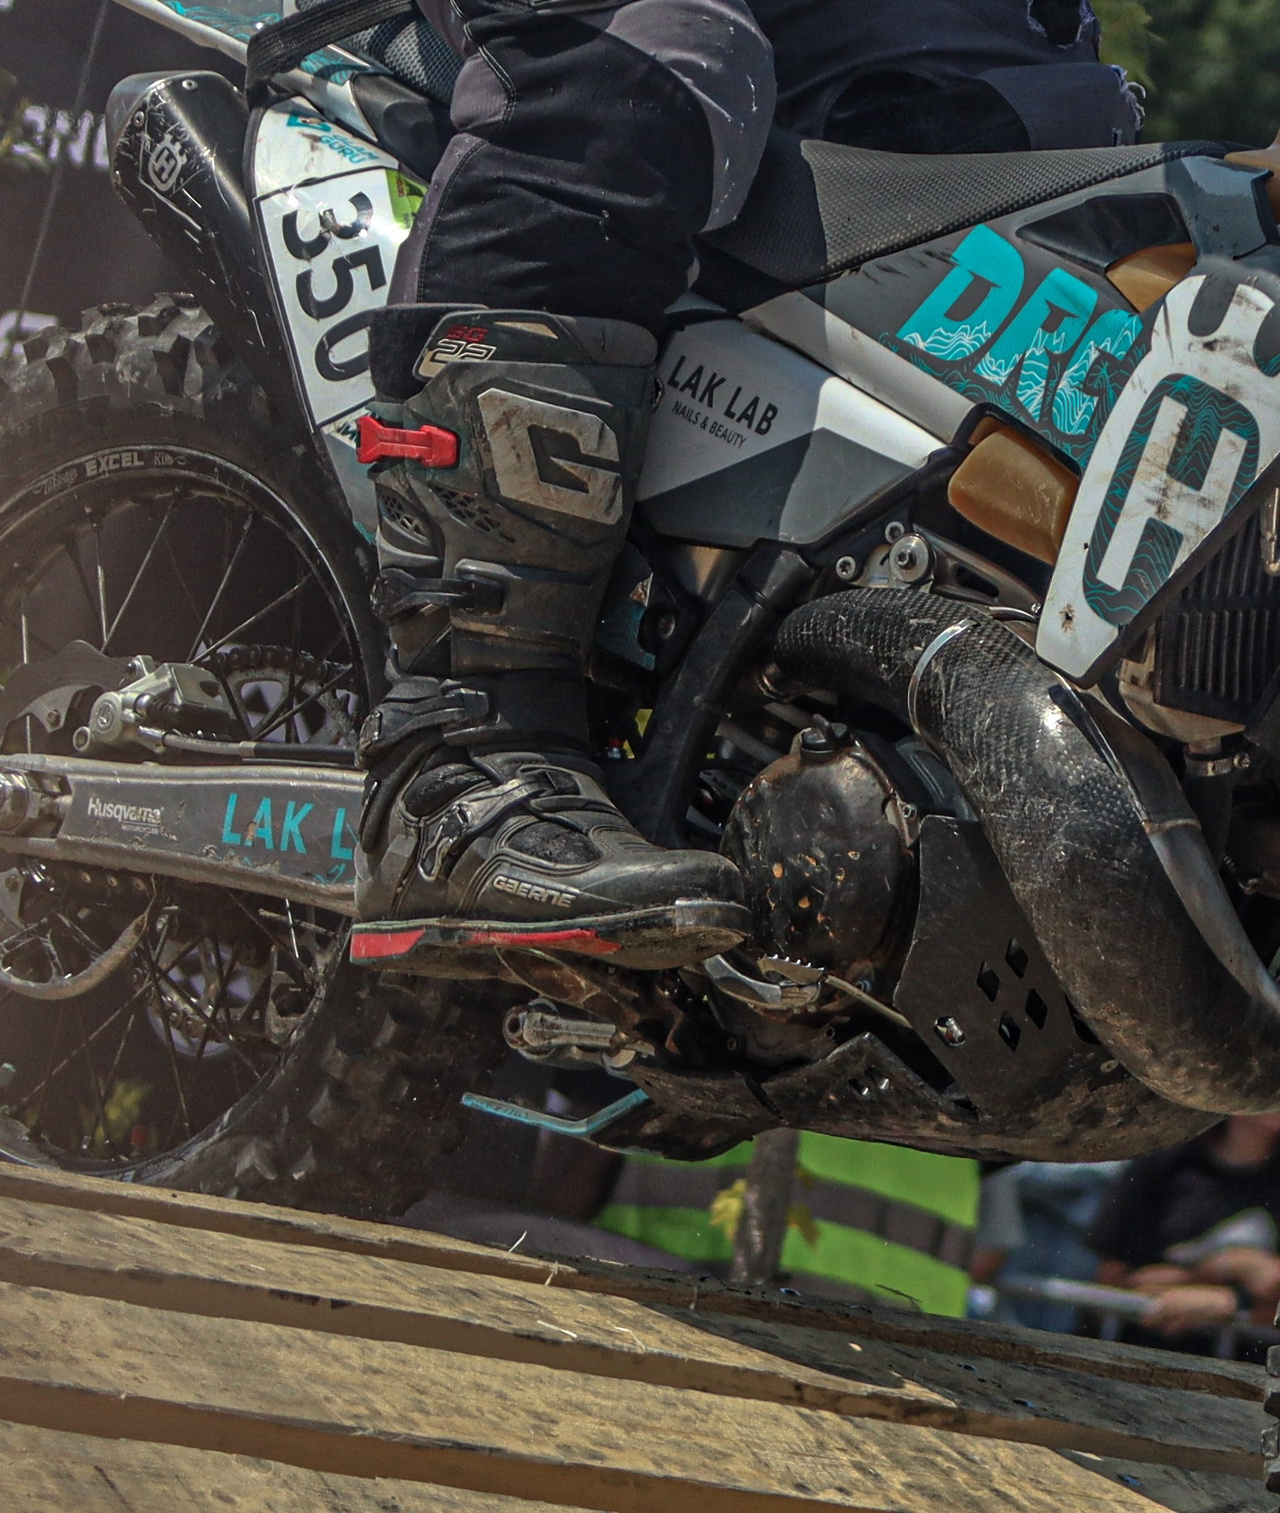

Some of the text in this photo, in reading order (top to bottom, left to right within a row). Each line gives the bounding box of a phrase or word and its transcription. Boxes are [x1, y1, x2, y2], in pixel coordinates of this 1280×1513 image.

[280, 191, 389, 382] 350
[667, 355, 779, 436] LAK LAB
[672, 401, 748, 448] NAILS & BEAUTY
[84, 451, 145, 479] EXCEL
[221, 792, 316, 855] LAK
